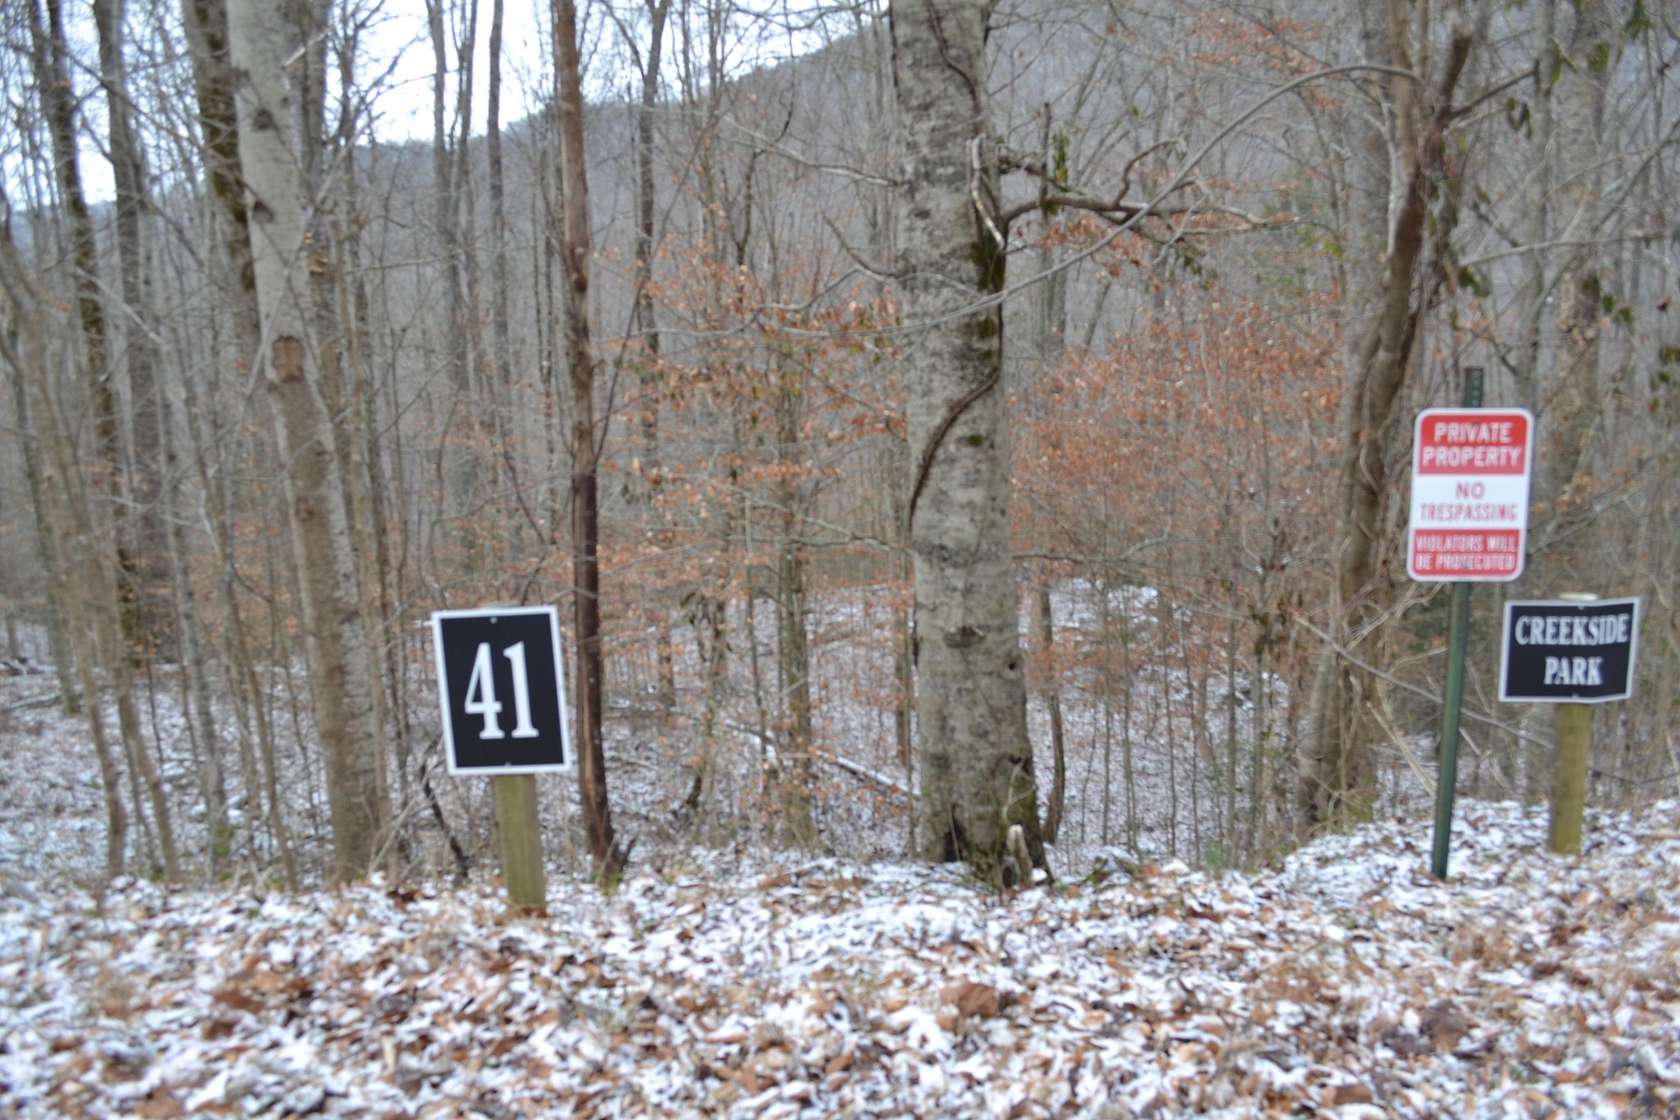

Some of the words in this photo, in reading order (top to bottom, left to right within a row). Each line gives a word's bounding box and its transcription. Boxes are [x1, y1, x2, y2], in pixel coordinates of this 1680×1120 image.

[1434, 422, 1513, 443] PRIVATE
[1422, 446, 1522, 467] PROPERTY
[1455, 482, 1486, 499] NO
[1420, 502, 1518, 521] TRESPASSING
[1415, 535, 1483, 552] VIOLATORS
[1487, 536, 1517, 552] WILL
[1415, 553, 1432, 569] BE
[1514, 613, 1630, 645] CREEKSIDE
[1543, 656, 1604, 685] PARK
[464, 641, 540, 739] 41
